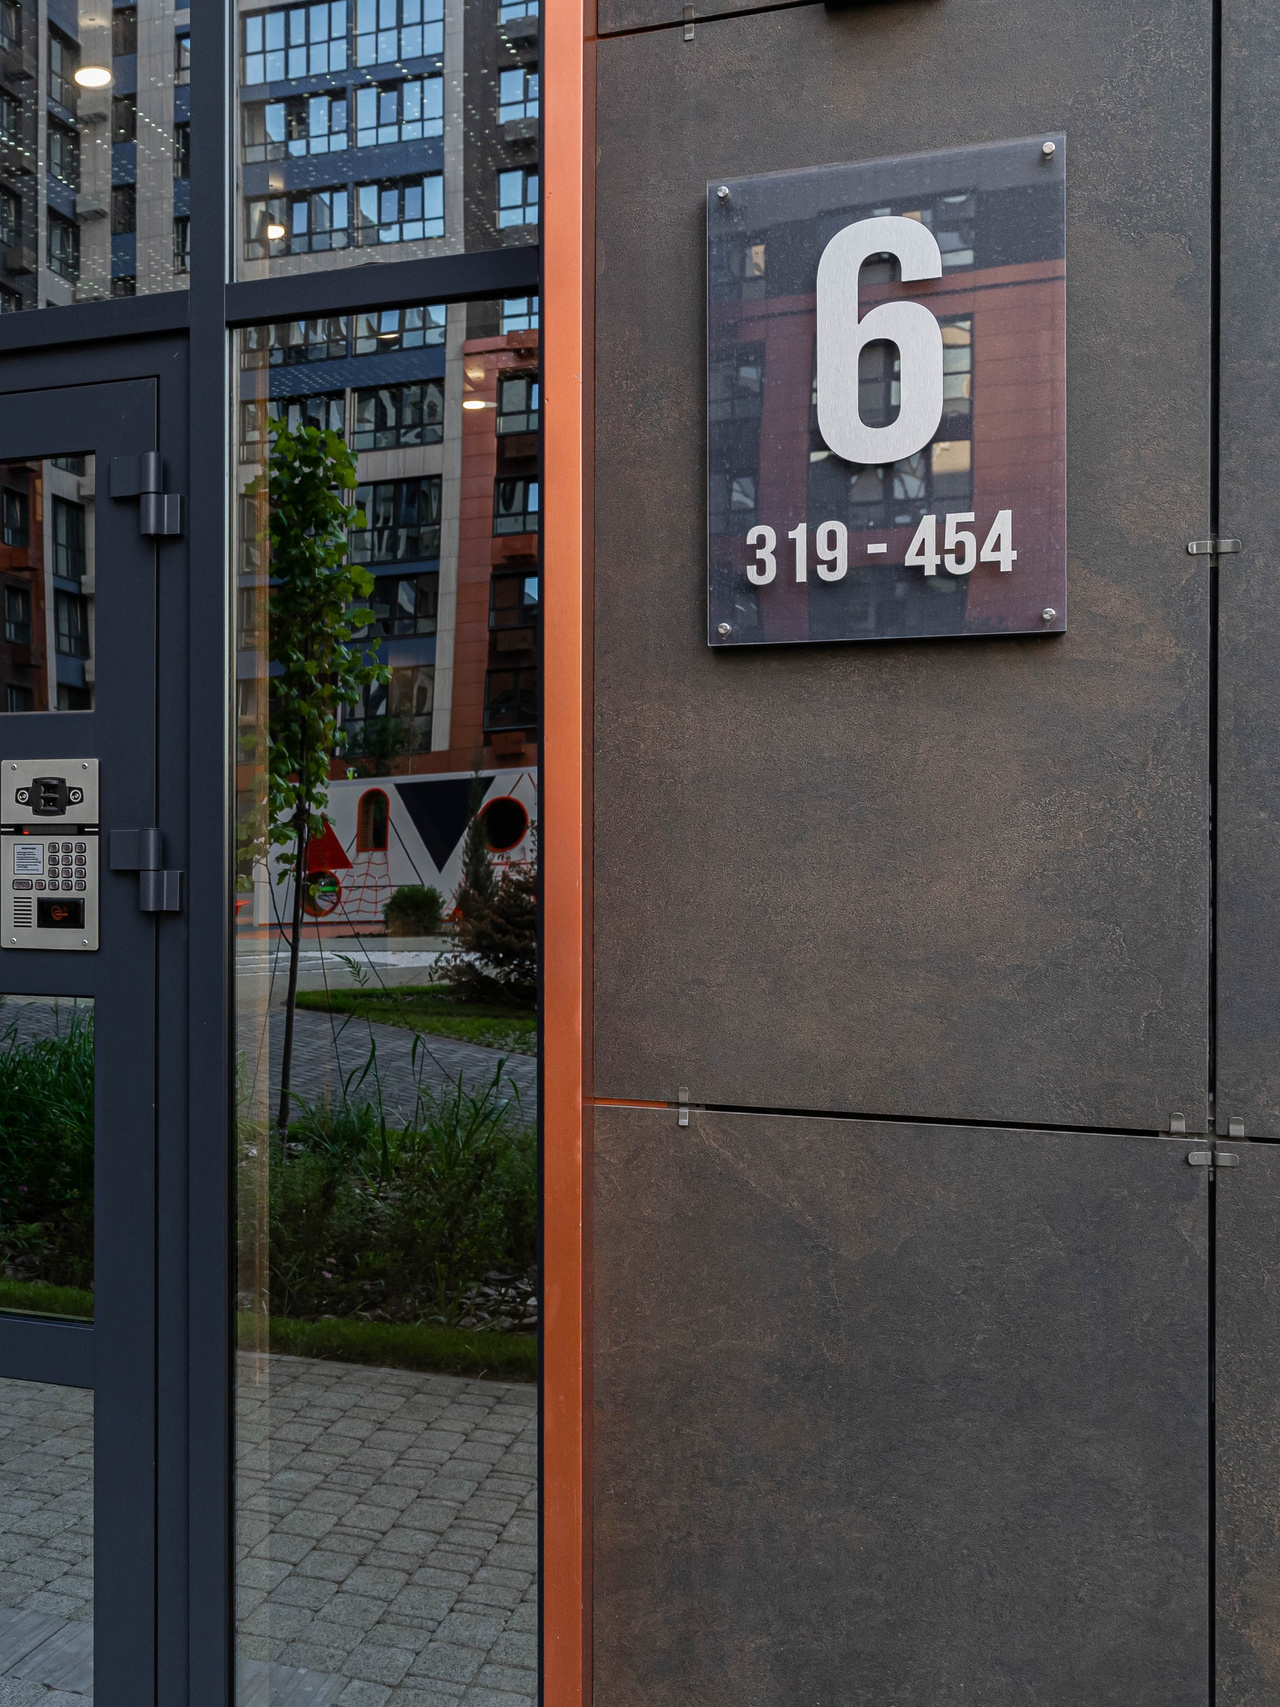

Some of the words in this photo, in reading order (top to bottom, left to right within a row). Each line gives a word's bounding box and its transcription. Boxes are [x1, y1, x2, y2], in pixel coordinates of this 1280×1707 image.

[815, 215, 944, 465] 6
[745, 519, 849, 586] 319
[904, 508, 1018, 577] 454
